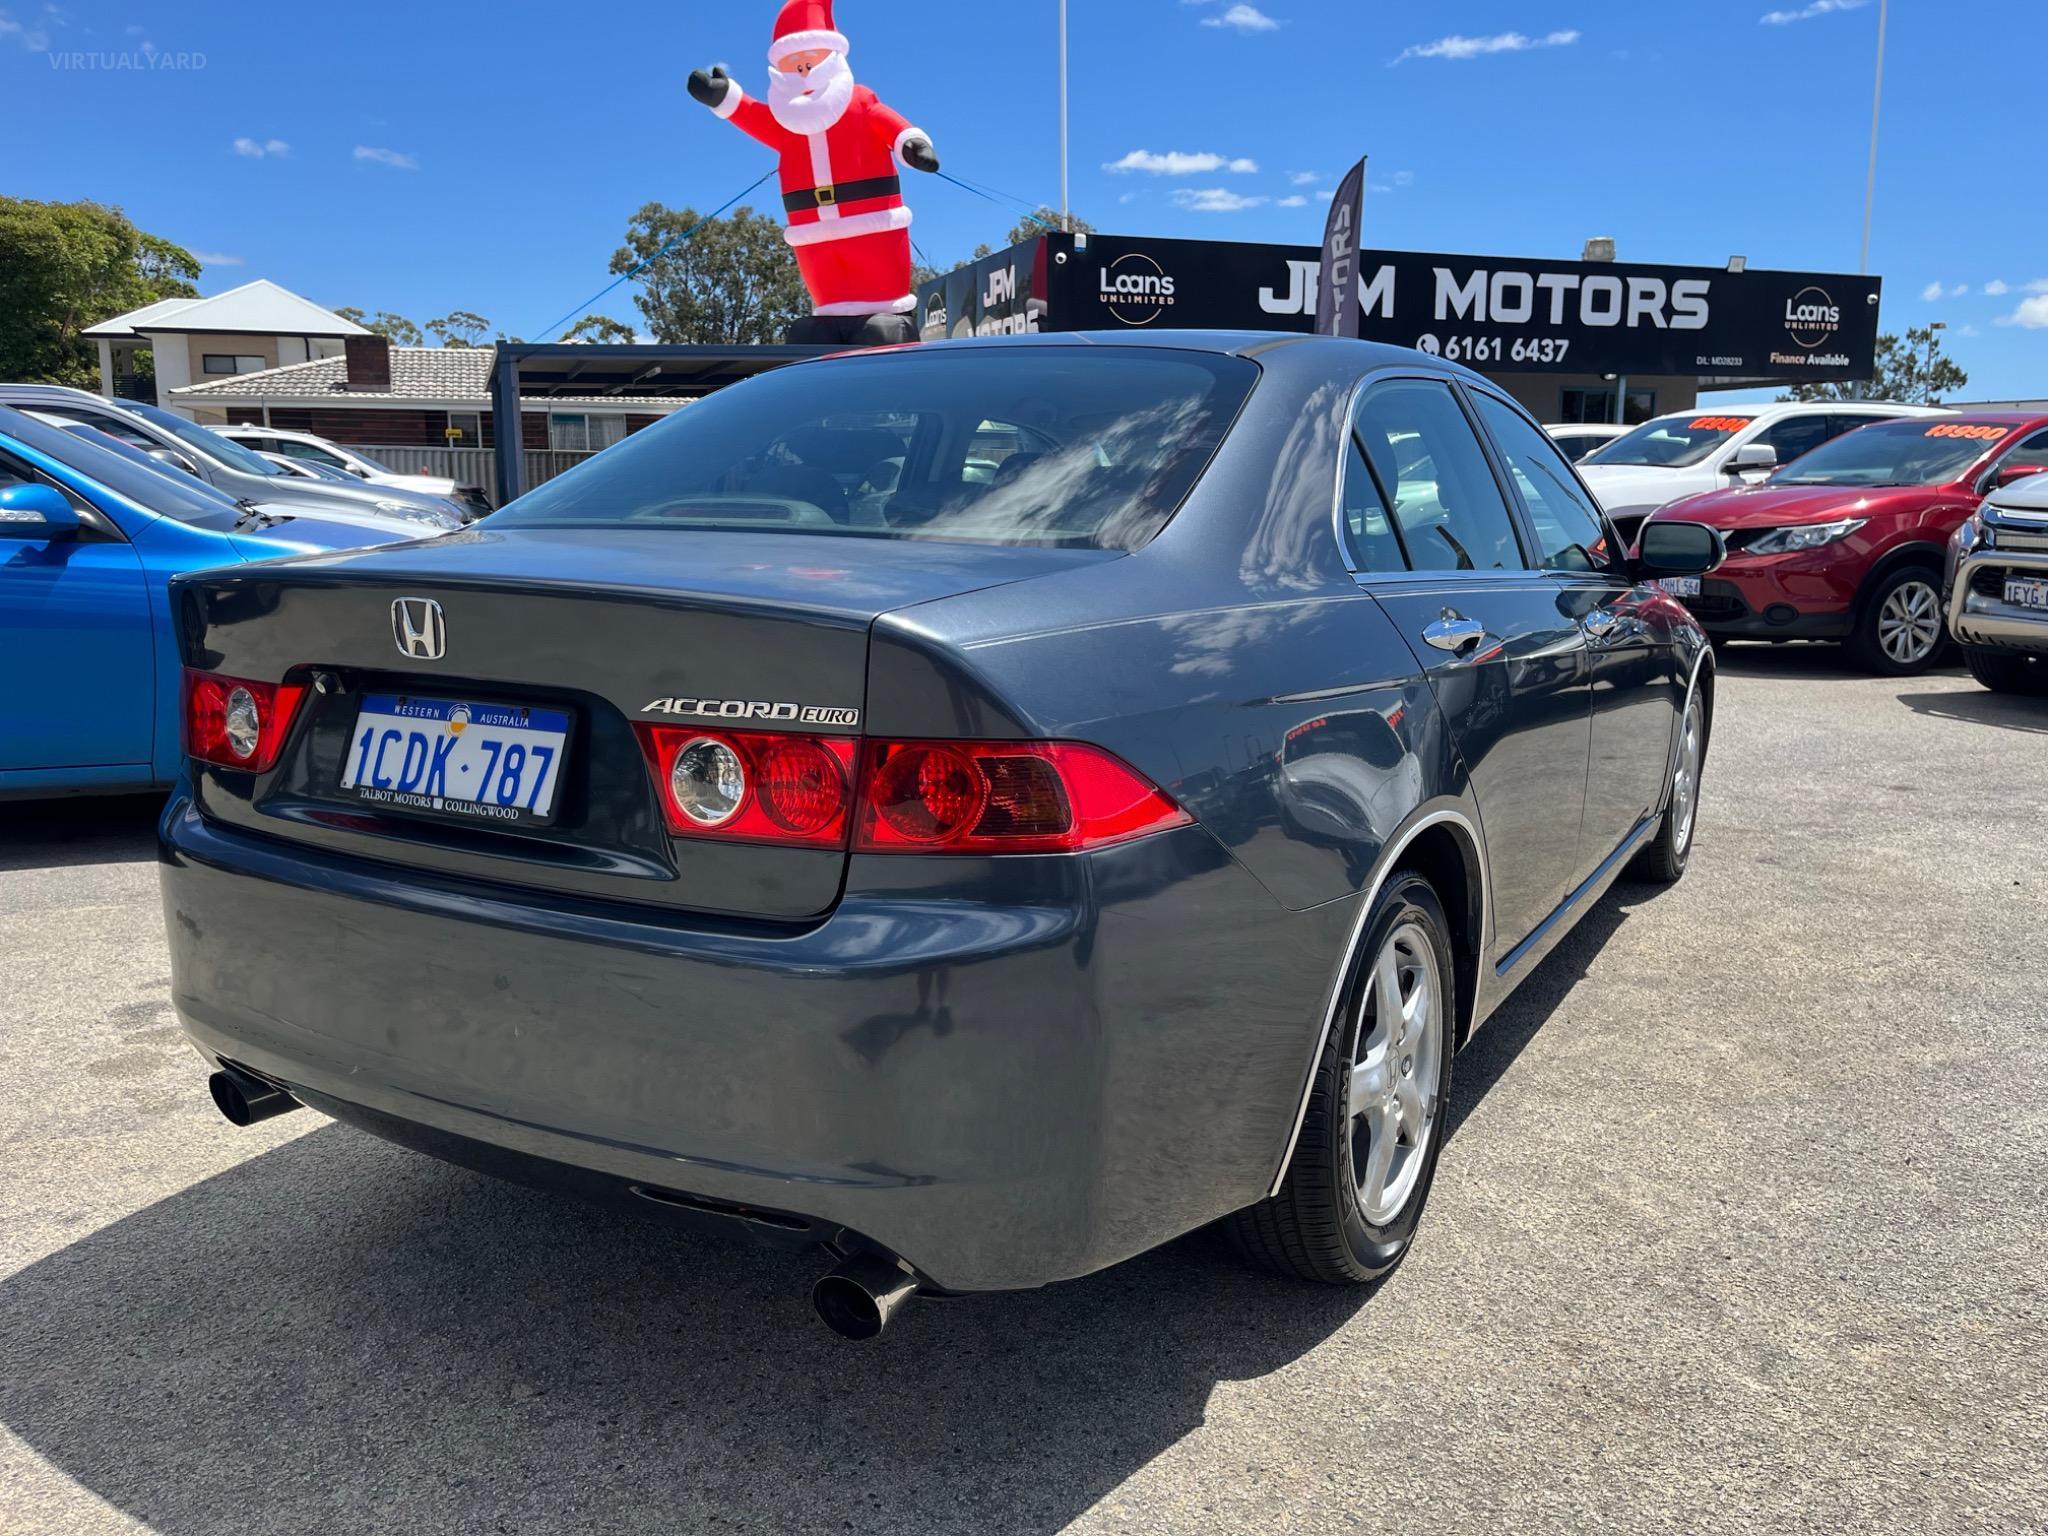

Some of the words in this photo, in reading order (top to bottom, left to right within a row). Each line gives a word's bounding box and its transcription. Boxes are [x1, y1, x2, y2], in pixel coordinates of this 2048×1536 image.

[983, 264, 1016, 308] JPM
[1100, 267, 1175, 295] Loans
[1100, 294, 1175, 305] UNLIMITED
[1432, 267, 1711, 329] MOTORS
[1785, 299, 1840, 322] Loans
[1784, 321, 1839, 331] UNLIMITED
[1445, 336, 1501, 360] 6161
[1511, 338, 1569, 363] 6437
[1770, 352, 1806, 365] Finance
[1807, 353, 1850, 366] Available
[394, 705, 440, 718] WESTERN
[480, 713, 529, 728] AUSTRALIA
[640, 697, 799, 719] ACCORD
[801, 706, 858, 725] EURO
[359, 788, 392, 802] TALBOT
[393, 793, 431, 808] MOTORS
[445, 800, 519, 820] COLLINGWOOD
